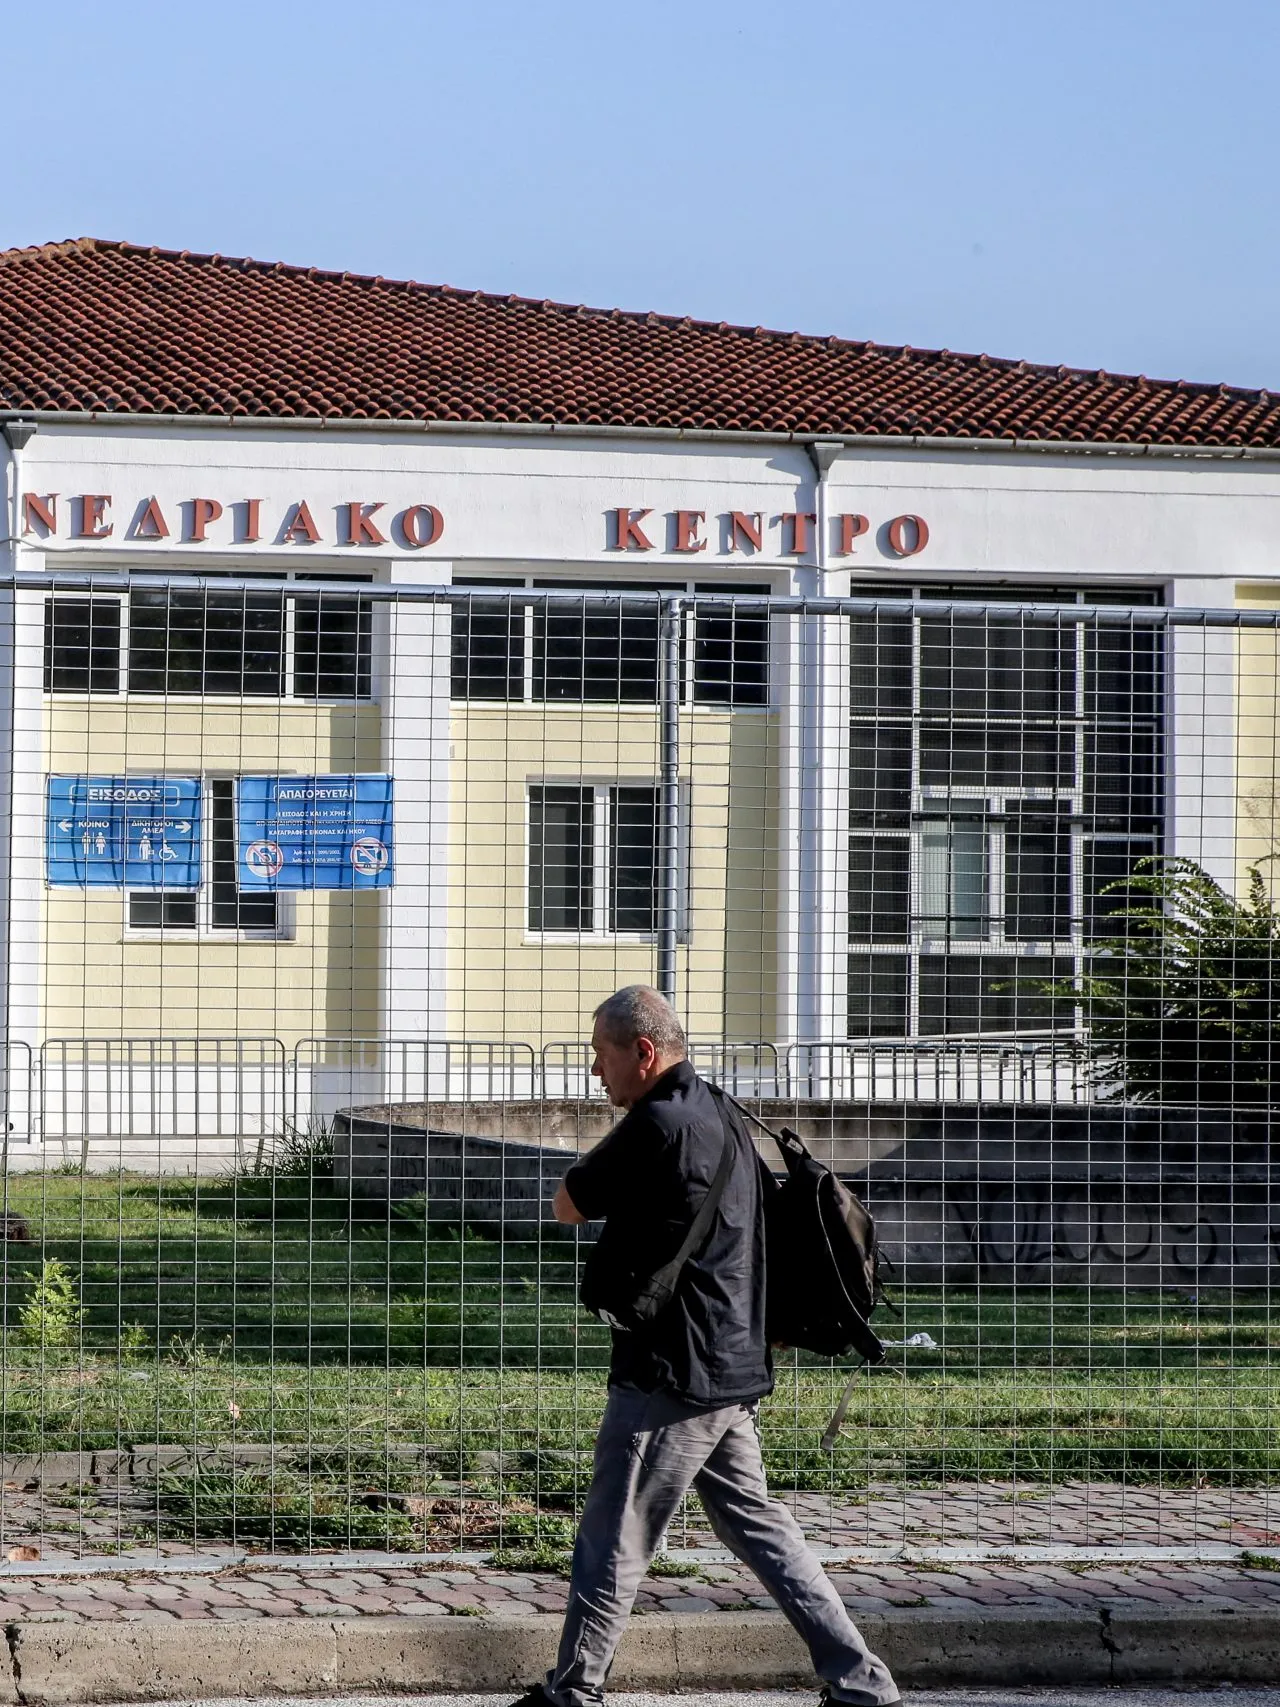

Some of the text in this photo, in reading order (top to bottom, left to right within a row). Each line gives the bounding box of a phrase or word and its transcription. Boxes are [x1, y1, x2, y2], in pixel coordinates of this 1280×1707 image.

[23, 492, 445, 548] ΝΕΔΡΙΑΚΟ
[614, 507, 930, 557] ΚΕΝΤΡΟ
[89, 788, 161, 801] ΕΙΣΟΔΟΣ
[278, 789, 353, 799] ΑΠΑΓΟΡΕΥΕΤΑΙ
[78, 820, 110, 828] ΚΟΙΝΟ
[131, 820, 174, 828] ΔΙΚΗΓΟΡΟΙ
